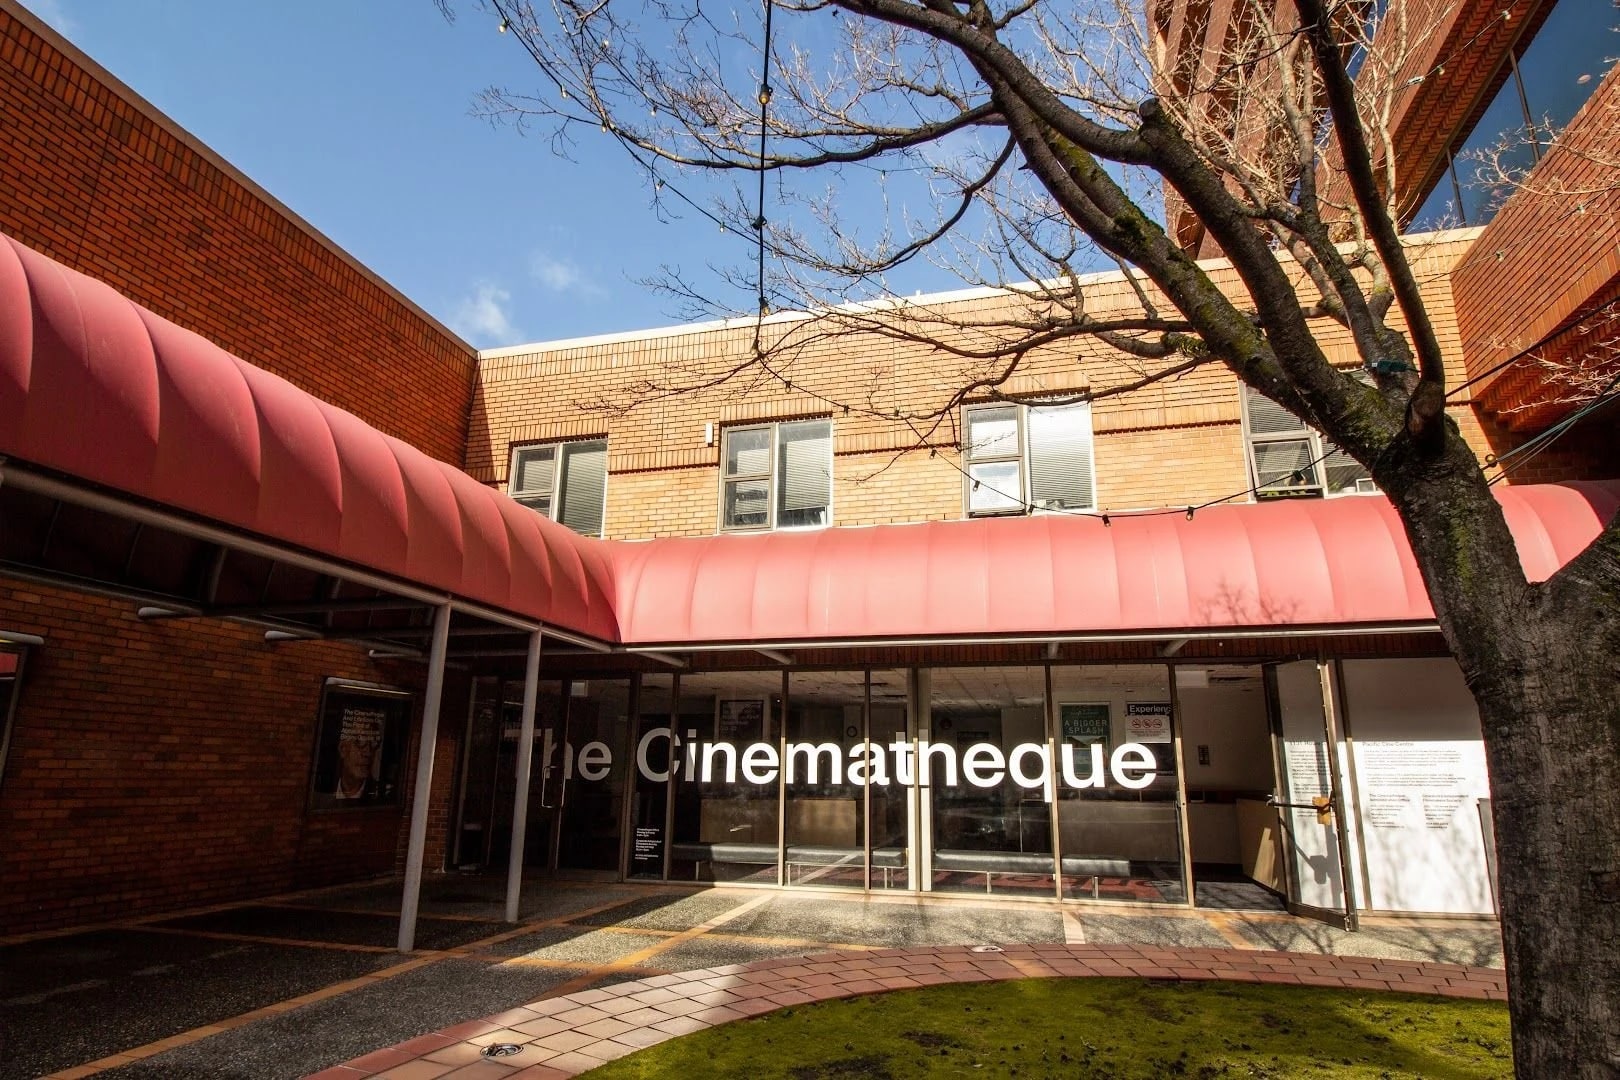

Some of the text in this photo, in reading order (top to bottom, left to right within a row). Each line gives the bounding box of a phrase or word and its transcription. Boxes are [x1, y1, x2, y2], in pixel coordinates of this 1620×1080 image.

[1064, 719, 1070, 727] A
[1068, 726, 1104, 735] SPLASH
[636, 727, 1157, 803] Cinematheque
